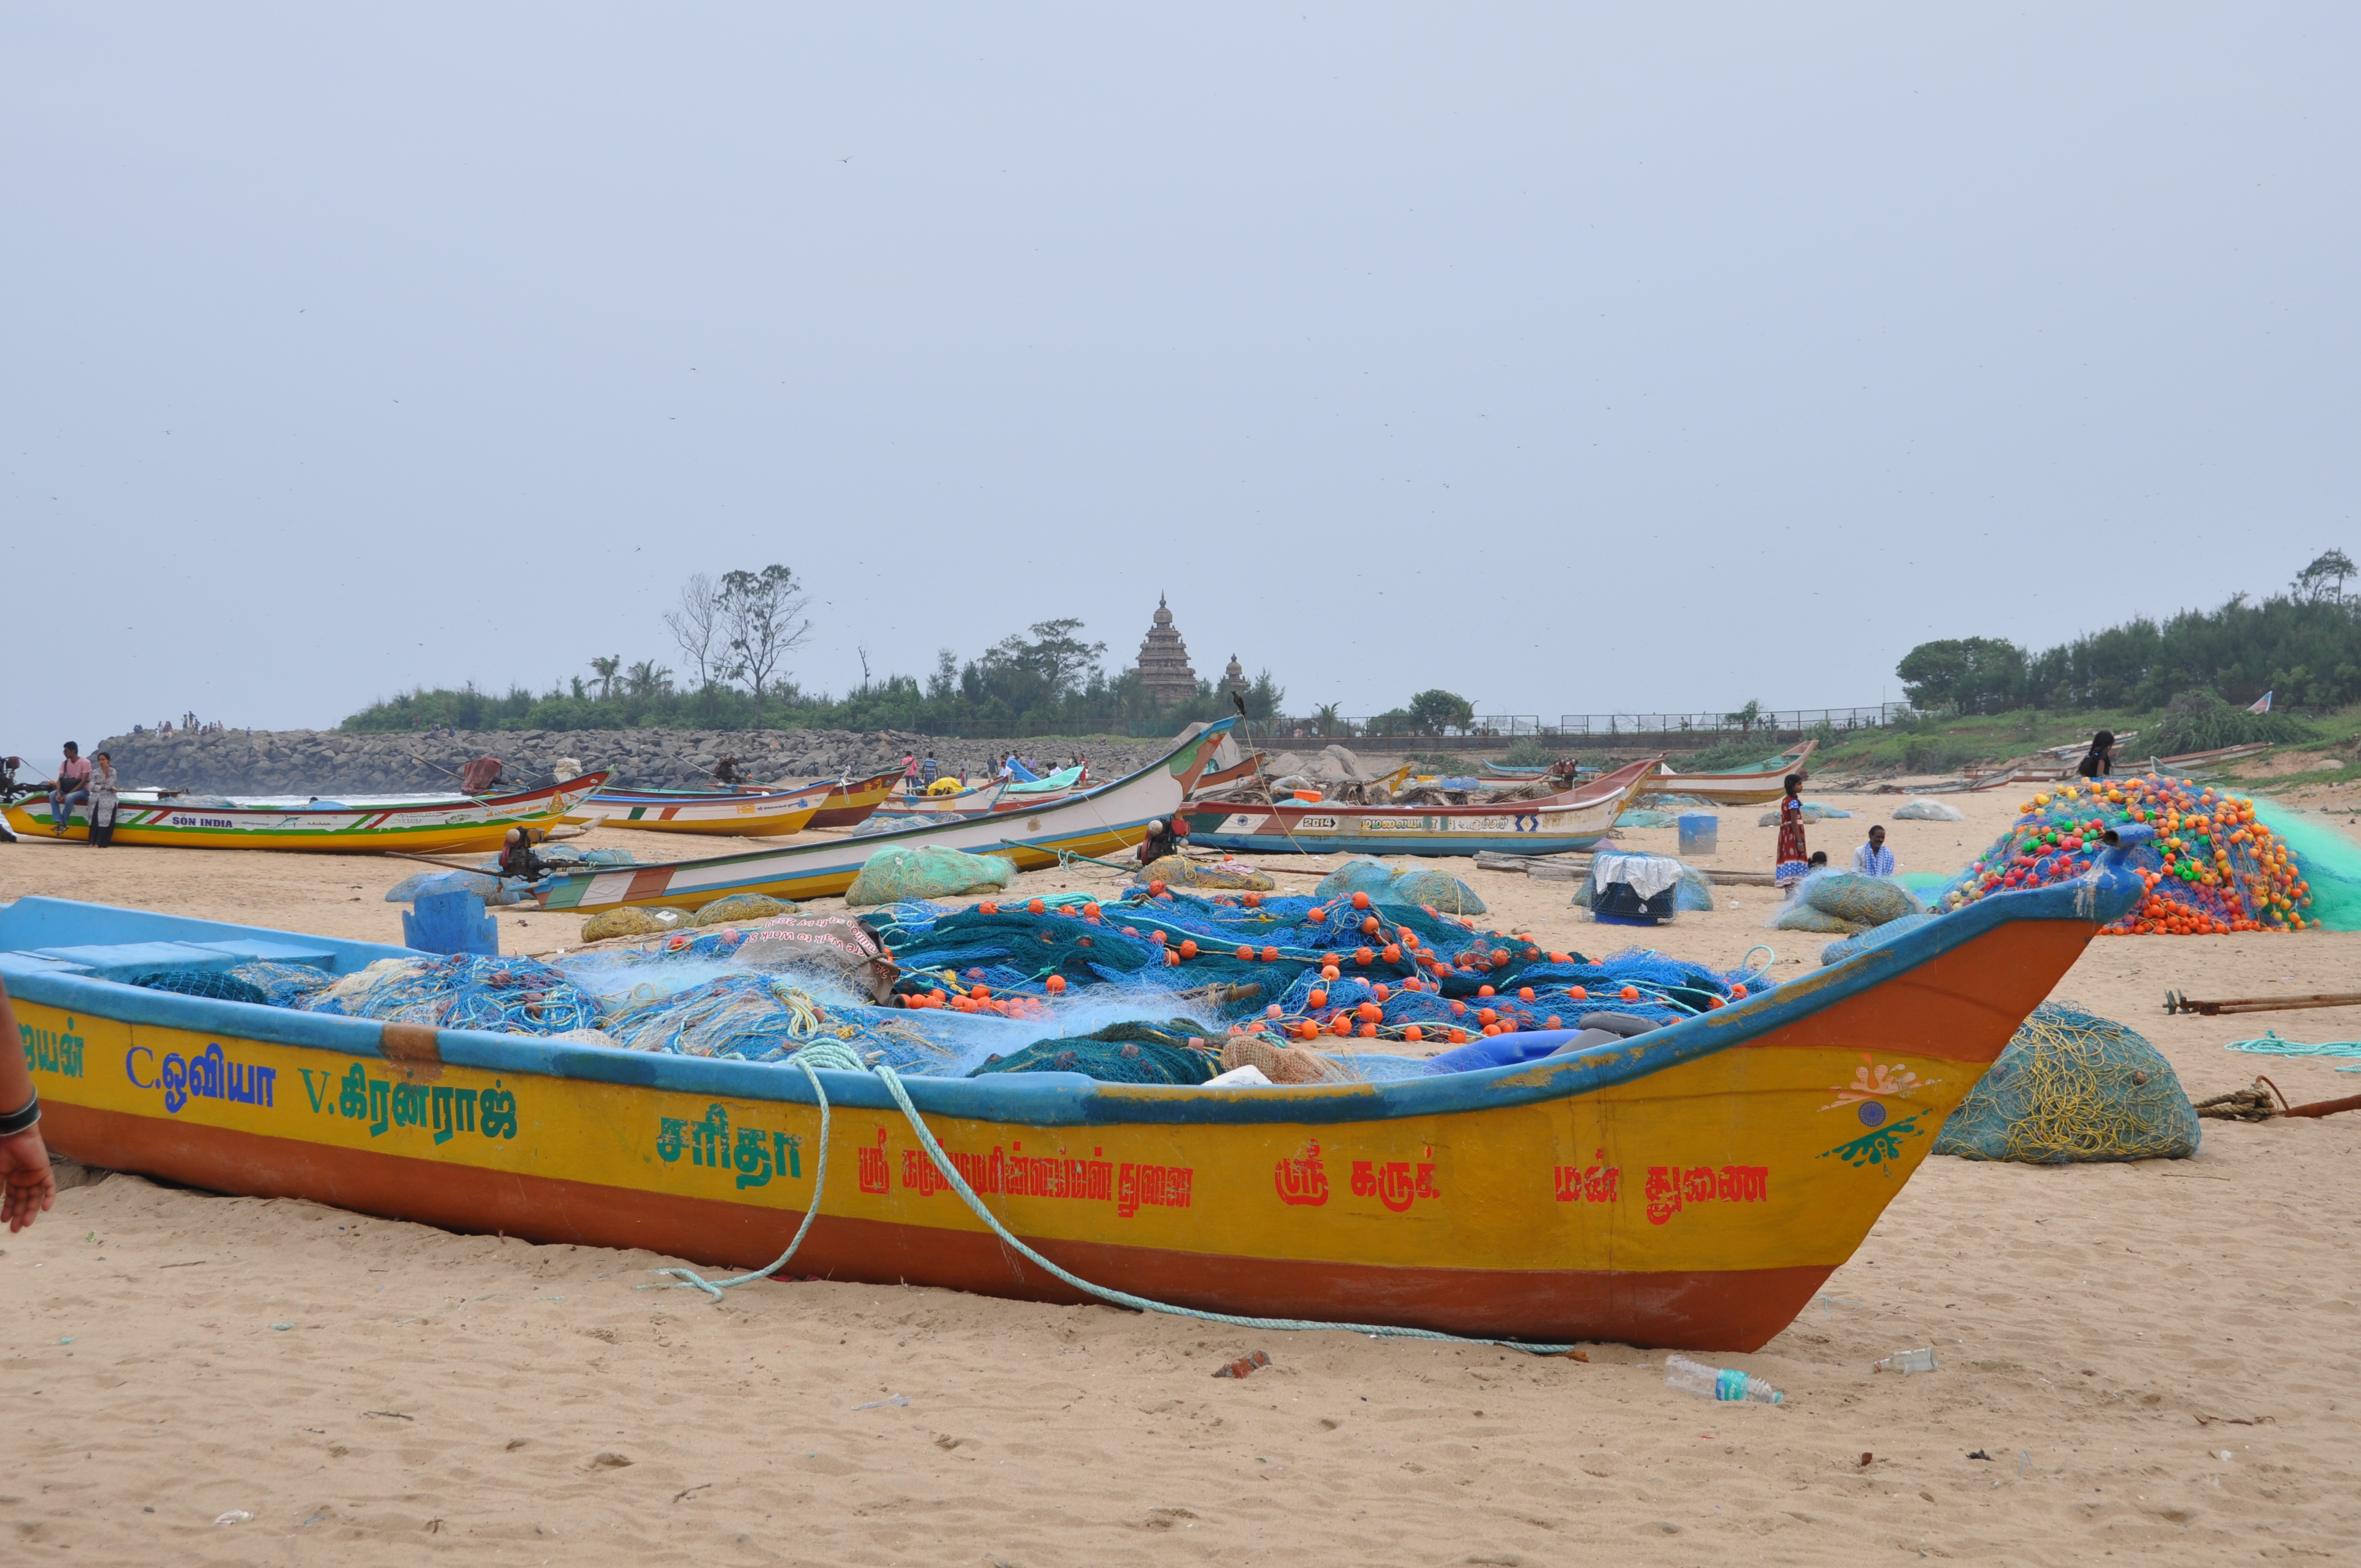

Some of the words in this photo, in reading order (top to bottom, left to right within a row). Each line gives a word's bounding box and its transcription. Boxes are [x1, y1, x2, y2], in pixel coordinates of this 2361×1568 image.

[172, 816, 196, 826] SON
[200, 818, 233, 828] INDIA
[1303, 818, 1332, 827] 2014
[760, 930, 795, 941] Work
[797, 933, 812, 941] to
[814, 934, 844, 950] Walk
[846, 921, 878, 954] million
[20, 1017, 84, 1077] ஜயன்
[656, 1103, 802, 1190] சரிதா
[1645, 1166, 1769, 1226] துணை
